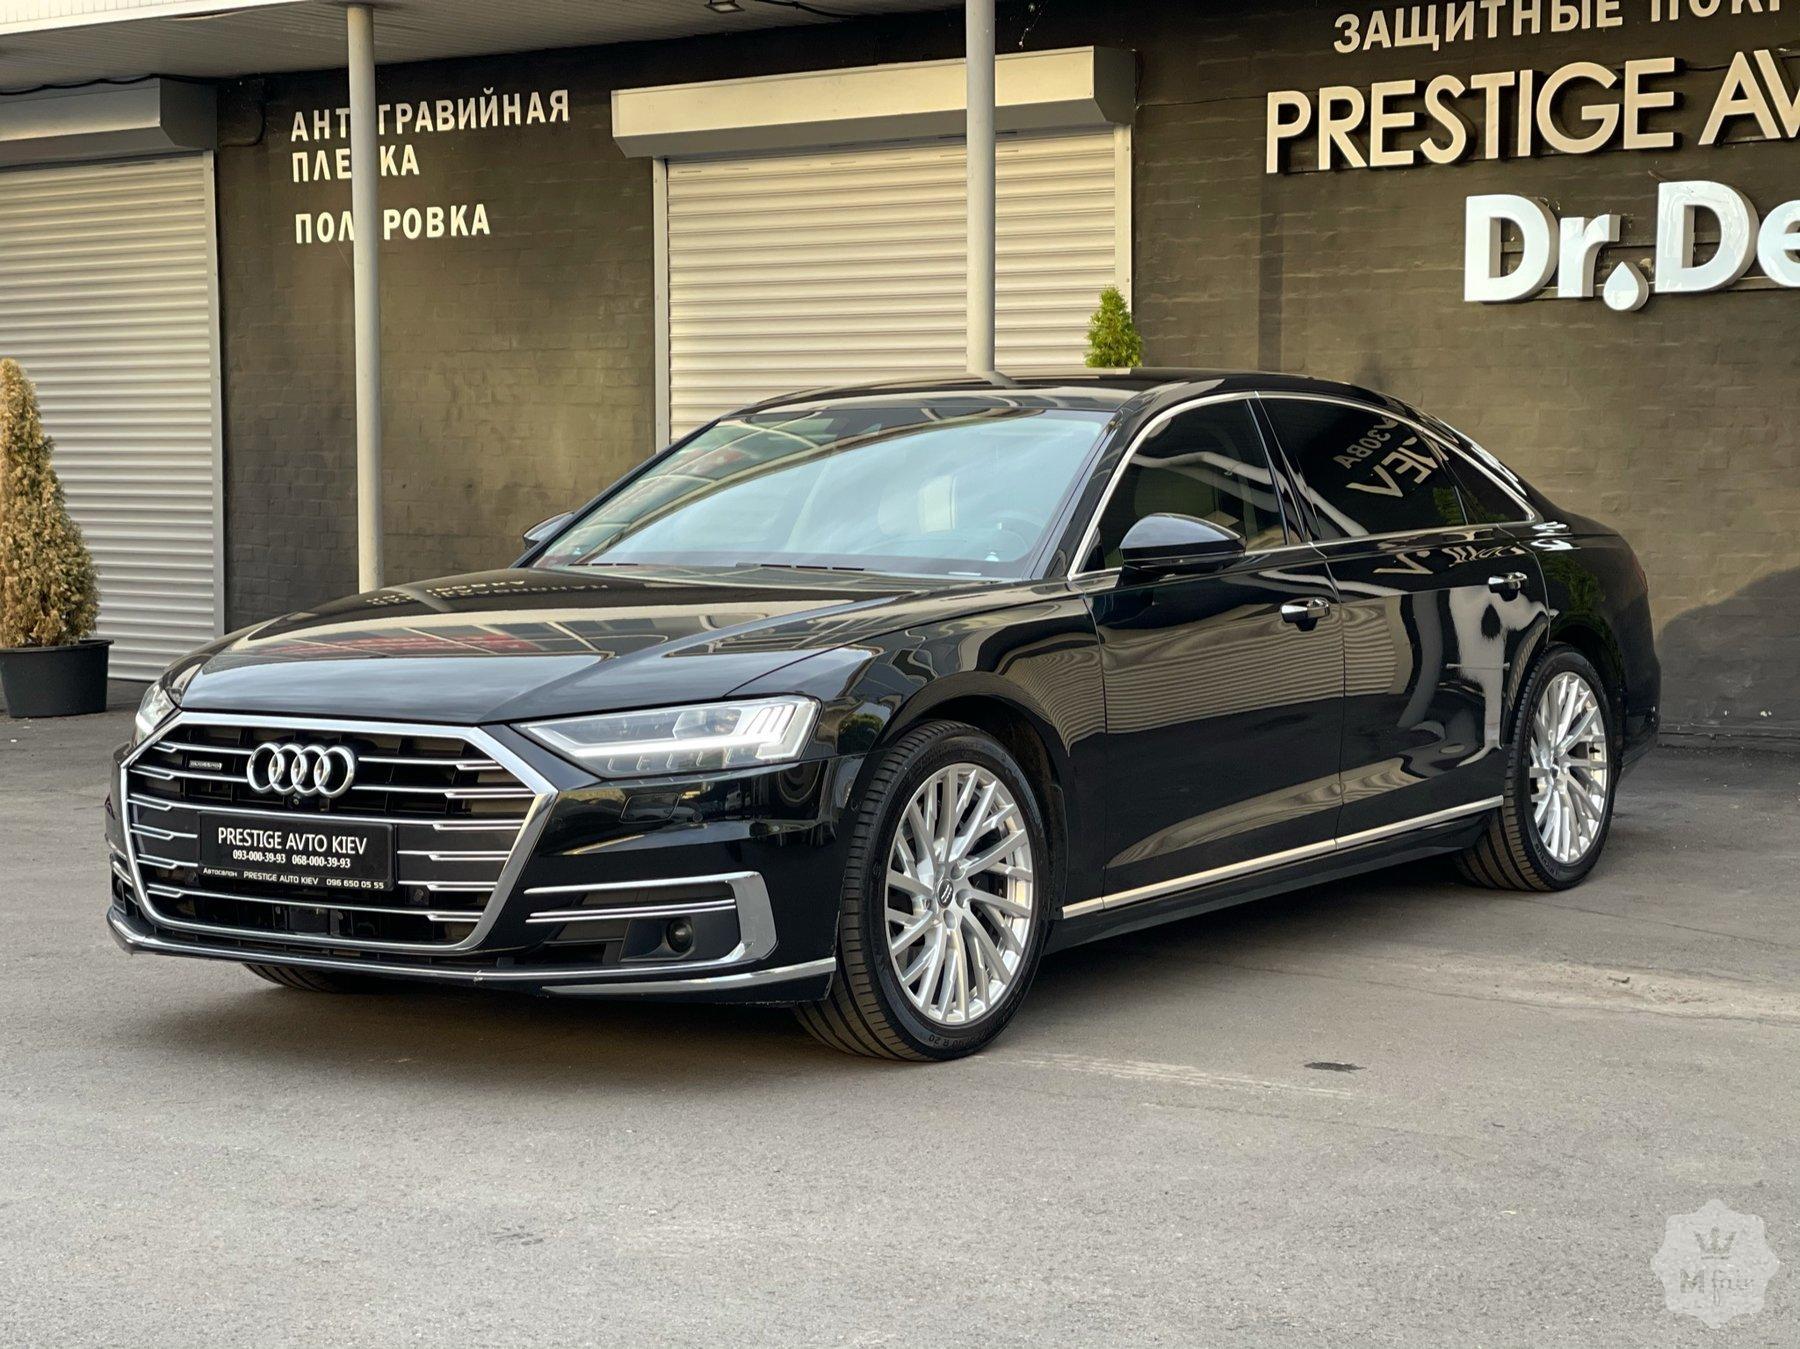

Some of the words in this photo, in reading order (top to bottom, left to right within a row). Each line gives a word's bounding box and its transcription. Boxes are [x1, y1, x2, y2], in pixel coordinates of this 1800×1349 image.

[1333, 0, 1624, 54] ЗАЩИТНЫЕ
[291, 87, 570, 142] АНТГРАВИЙНАЯ
[1266, 57, 1676, 174] PRESTIGE
[292, 144, 420, 183] ПЛЕКА
[295, 203, 491, 244] ПОЛРОВКА
[218, 827, 282, 850] PRESTIGE
[286, 833, 327, 852] AVTO
[332, 836, 367, 855] KIEV
[232, 849, 286, 864] 093-000-39-93
[292, 854, 351, 868] 068-000-39-93
[243, 871, 277, 882] PRESTIGE
[279, 874, 299, 884] AUTO
[300, 876, 319, 885] KIEV
[326, 877, 342, 887] 096
[360, 880, 371, 889] 05
